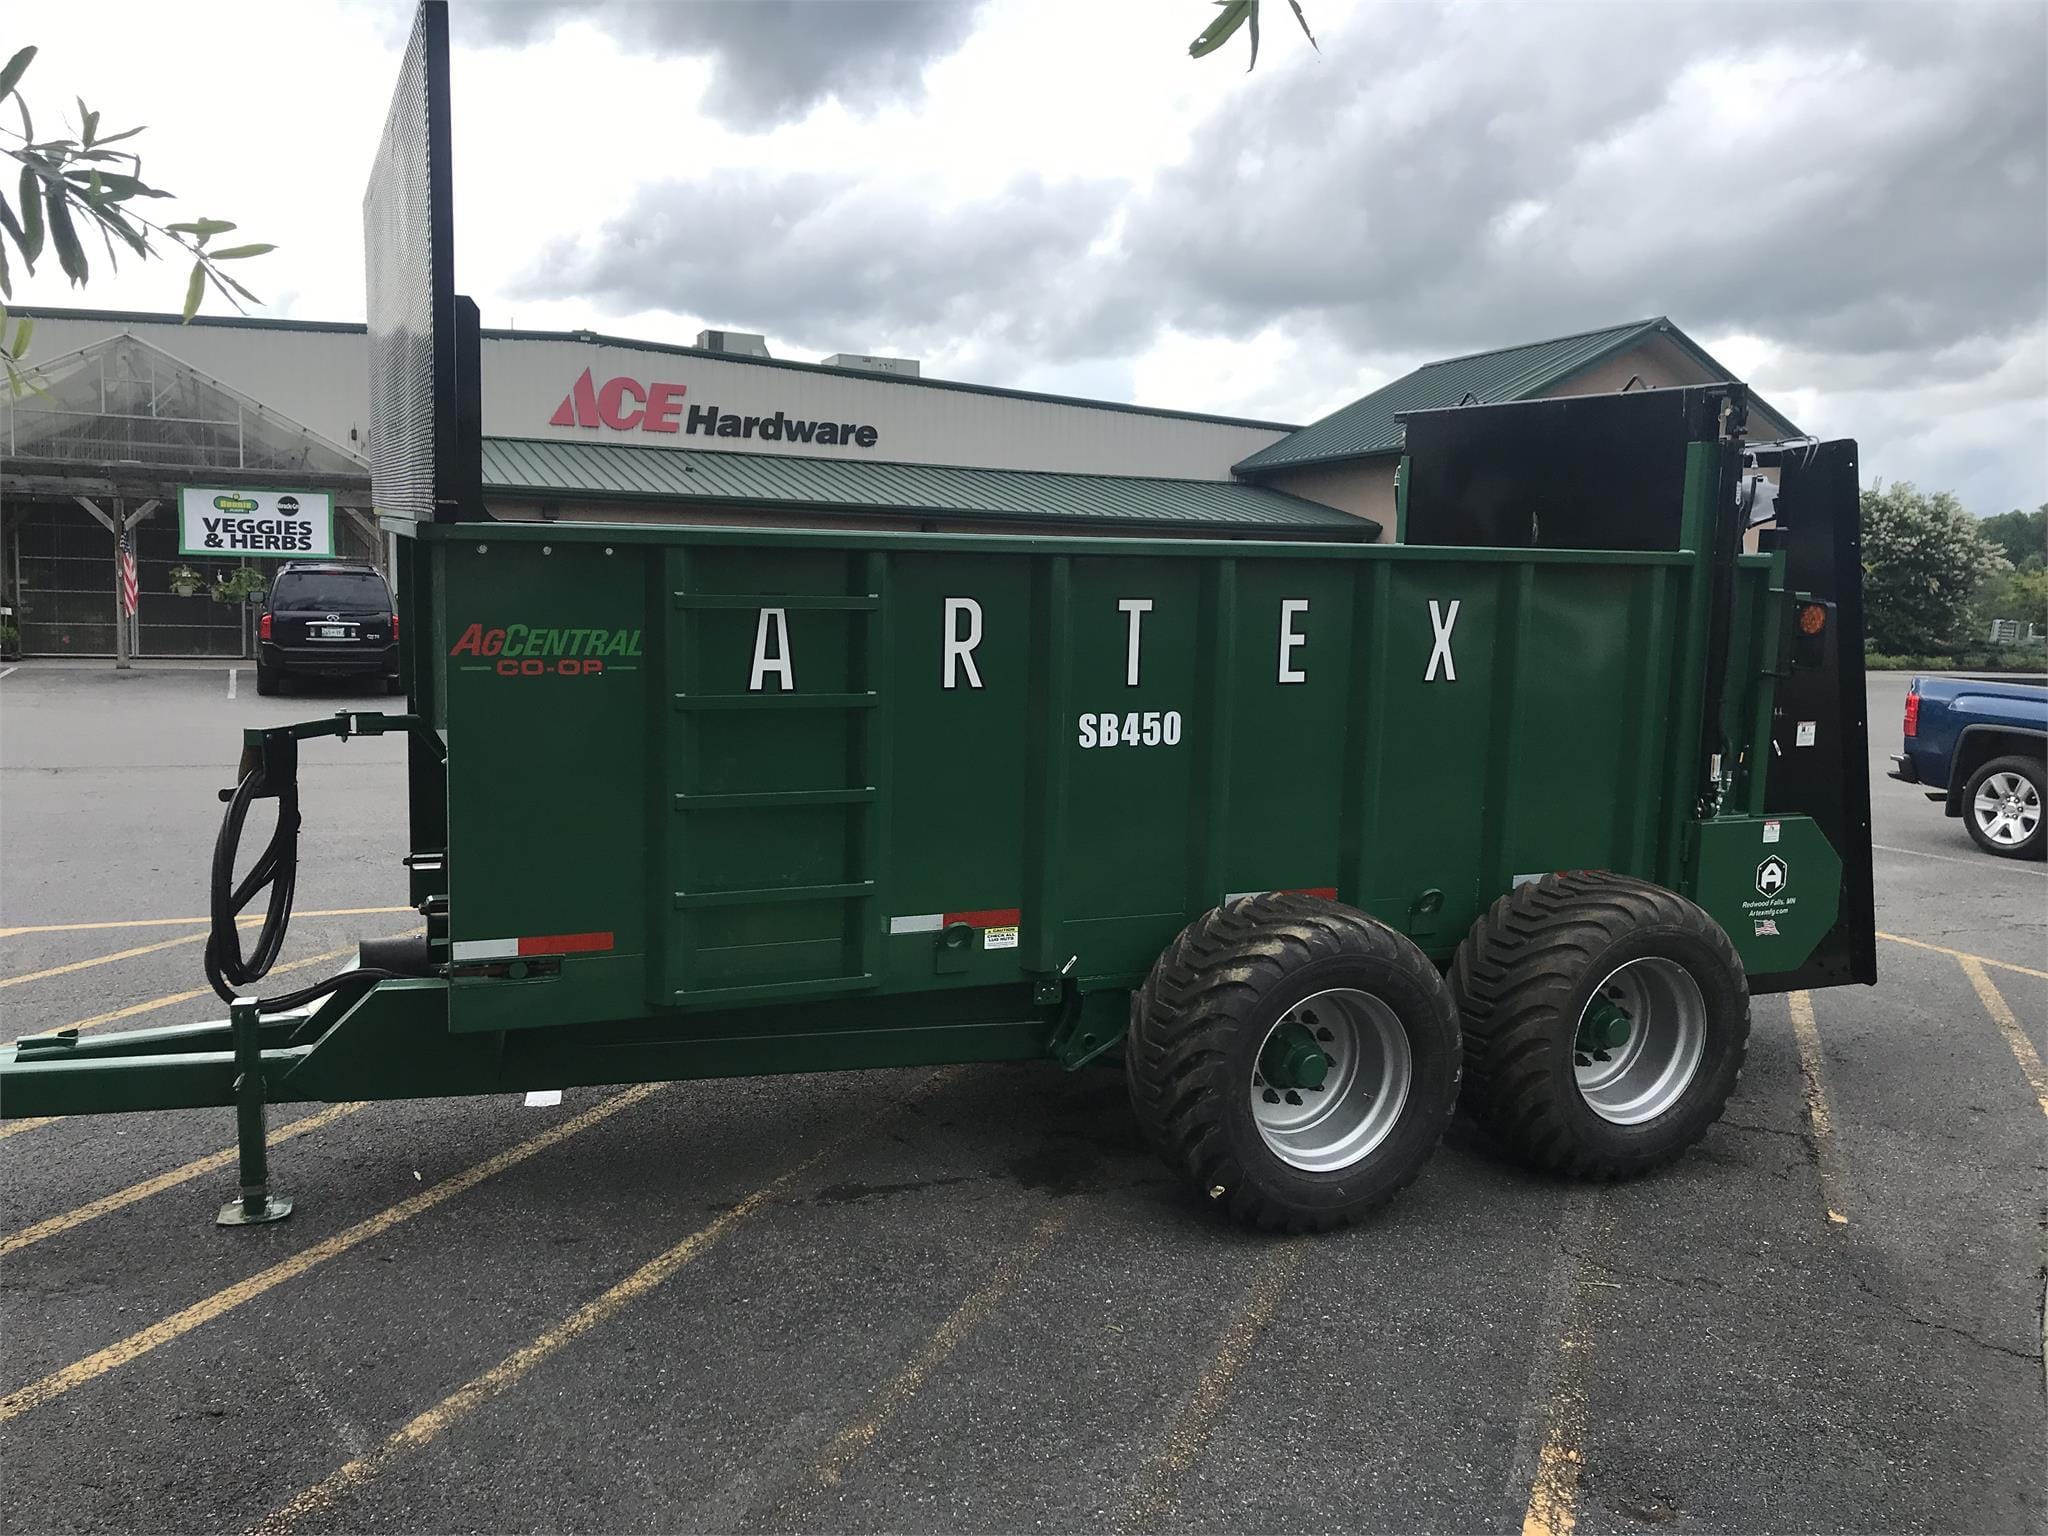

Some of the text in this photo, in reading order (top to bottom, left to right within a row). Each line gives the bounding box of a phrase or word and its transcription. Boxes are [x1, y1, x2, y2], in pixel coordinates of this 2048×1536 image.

[549, 366, 879, 448] ACE Hardware
[202, 517, 313, 536] VEGGIES
[204, 533, 312, 551] & HERBS
[496, 659, 603, 676] CO-OP
[1078, 710, 1182, 748] SB450
